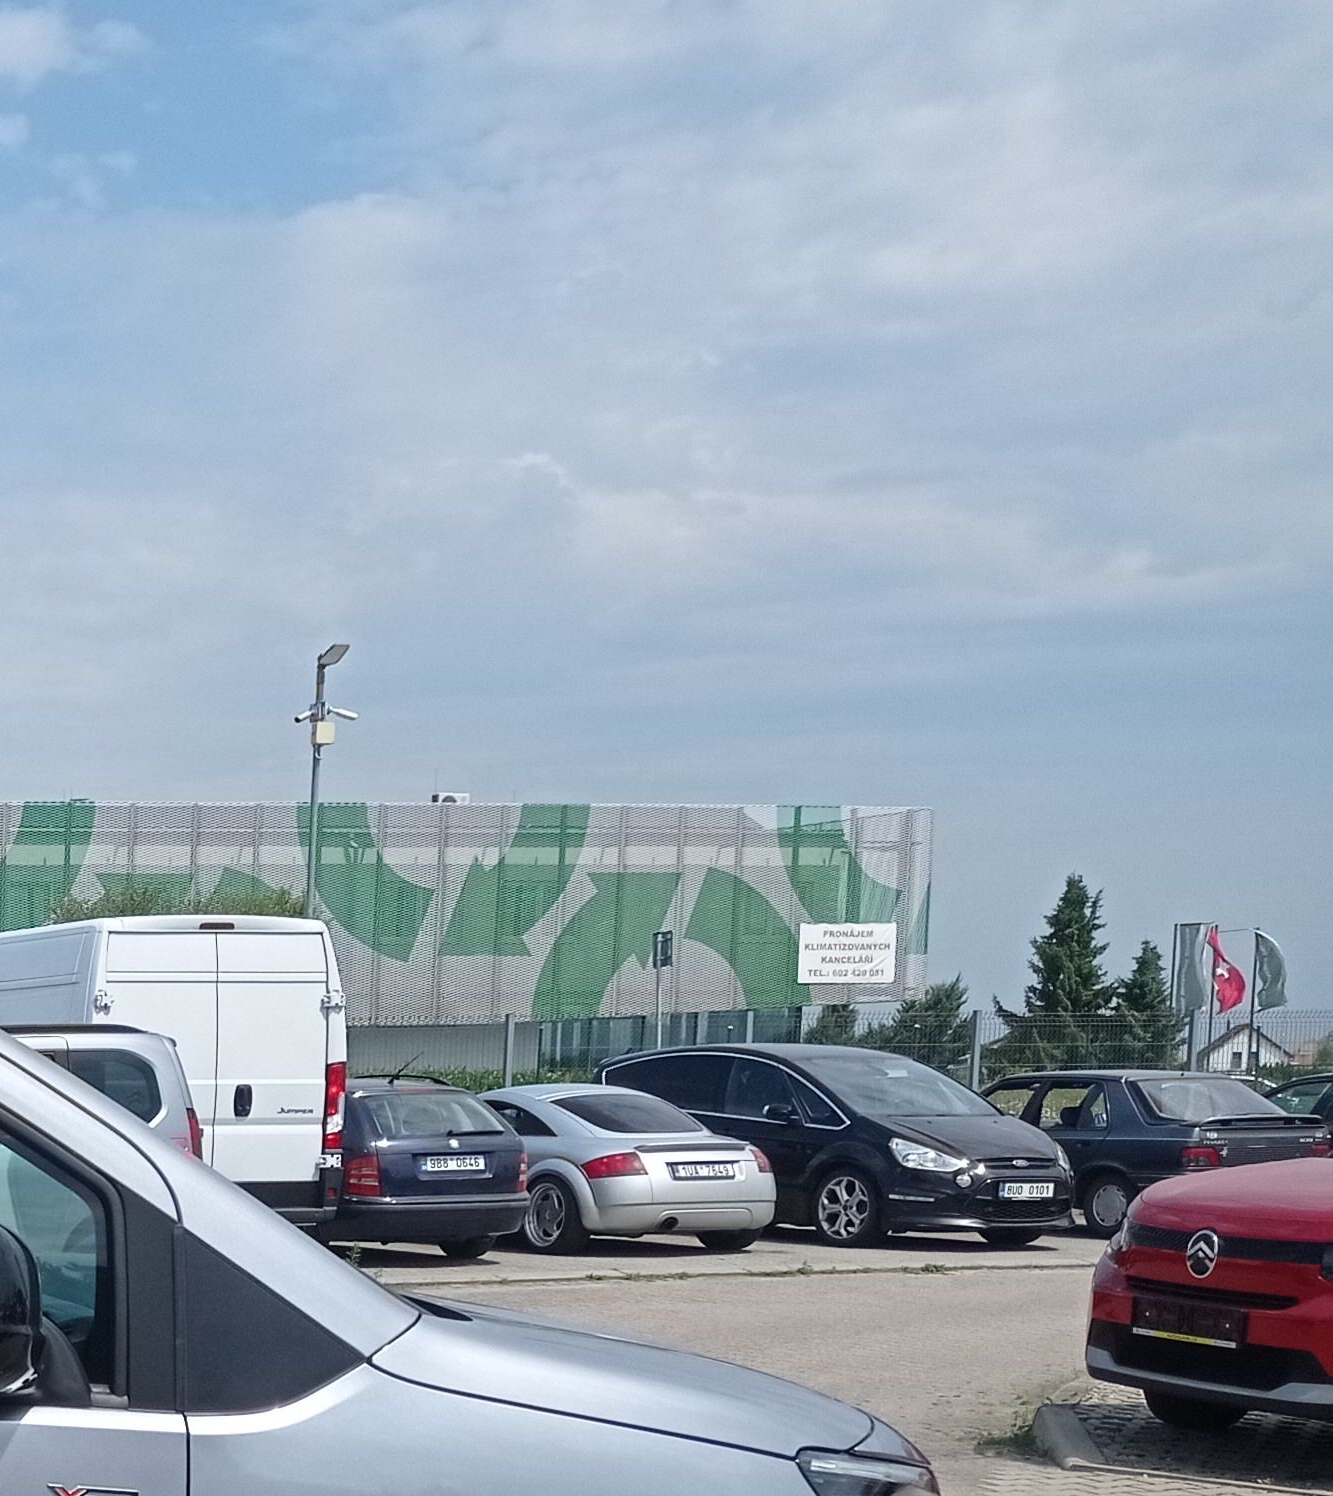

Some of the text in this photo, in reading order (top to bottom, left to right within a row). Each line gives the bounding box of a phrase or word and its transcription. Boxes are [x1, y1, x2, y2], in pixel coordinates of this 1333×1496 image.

[823, 928, 874, 938] PRONÁJEM
[430, 1156, 480, 1169] 9B8 0646
[1028, 1184, 1050, 1195] 0101
